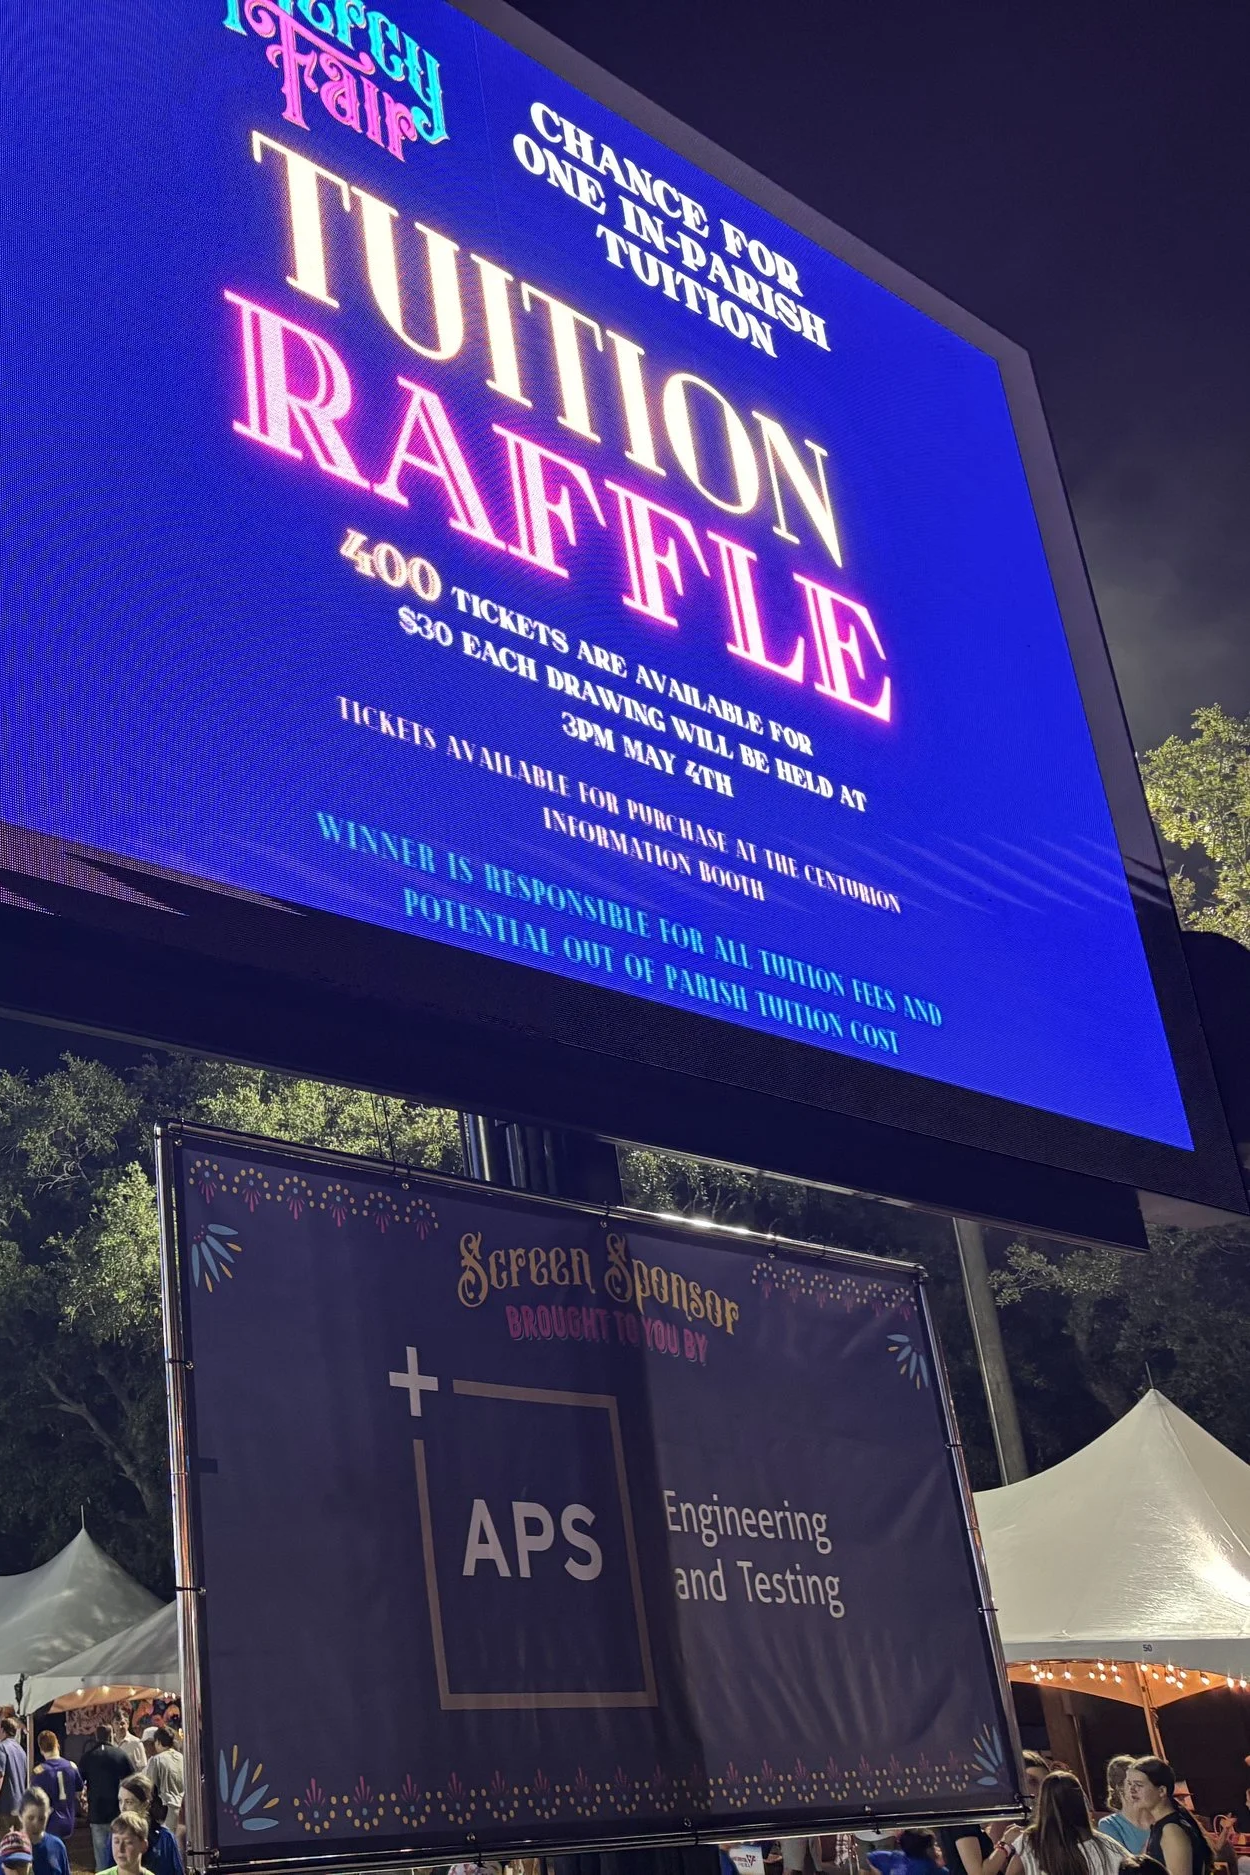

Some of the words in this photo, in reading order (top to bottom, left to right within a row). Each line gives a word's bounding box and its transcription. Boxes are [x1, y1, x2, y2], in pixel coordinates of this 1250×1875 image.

[223, 0, 450, 144] ercy
[244, 0, 417, 163] Fair
[512, 133, 606, 215] ONE
[619, 195, 832, 352] IN-PARISH
[530, 102, 709, 238] CHANCE
[720, 218, 804, 297] FOR
[251, 129, 844, 568] TUITION
[596, 224, 778, 358] TUITION
[223, 290, 892, 723] RAFFLE
[340, 528, 442, 601] 400
[450, 586, 569, 654] TICKETS
[577, 639, 628, 678] ARE
[636, 664, 764, 735] AVAILABLE
[769, 720, 814, 756] FOR
[398, 605, 453, 647] $30
[461, 631, 538, 682] EACH
[545, 664, 666, 732] DRAWING
[670, 715, 734, 760] WILL
[739, 743, 770, 774] BE
[774, 758, 834, 799] HELD
[840, 785, 867, 812] AT
[337, 696, 436, 750] TICKETS
[447, 735, 571, 798] AVAILABLE
[578, 781, 620, 815] FOR
[627, 798, 729, 854] PURCHASE
[736, 839, 758, 864] AT
[763, 848, 800, 878] THE
[804, 865, 901, 913] CENTURION
[561, 711, 616, 753] 3PM
[622, 735, 676, 775] MAY
[685, 760, 735, 798] 4TH
[317, 812, 436, 874] WINNER
[448, 852, 473, 883] IS
[484, 863, 651, 938] RESPONSIBLE
[659, 918, 705, 955] FOR
[714, 936, 752, 970] ALL
[758, 949, 845, 996] TUITION
[851, 978, 896, 1012] FEES
[903, 995, 942, 1027] AND
[543, 807, 691, 876] INFORMATION
[698, 860, 765, 901] BOOTH
[403, 888, 555, 956] POTENTIAL
[563, 936, 614, 972] OUT
[624, 953, 655, 984] OF
[664, 964, 748, 1012] PARISH
[755, 991, 843, 1039] TUITION
[850, 1020, 900, 1055] COST
[457, 1231, 596, 1308] Screen
[603, 1232, 740, 1335] Sponsor
[506, 1304, 611, 1342] BROUGHT
[613, 1310, 641, 1346] TO
[641, 1315, 680, 1357] YOU
[683, 1328, 709, 1366] BY
[462, 1498, 603, 1581] APS
[663, 1489, 832, 1555] Engineering
[675, 1558, 727, 1602] and
[736, 1560, 845, 1619] Testing
[56, 1770, 67, 1800] 1
